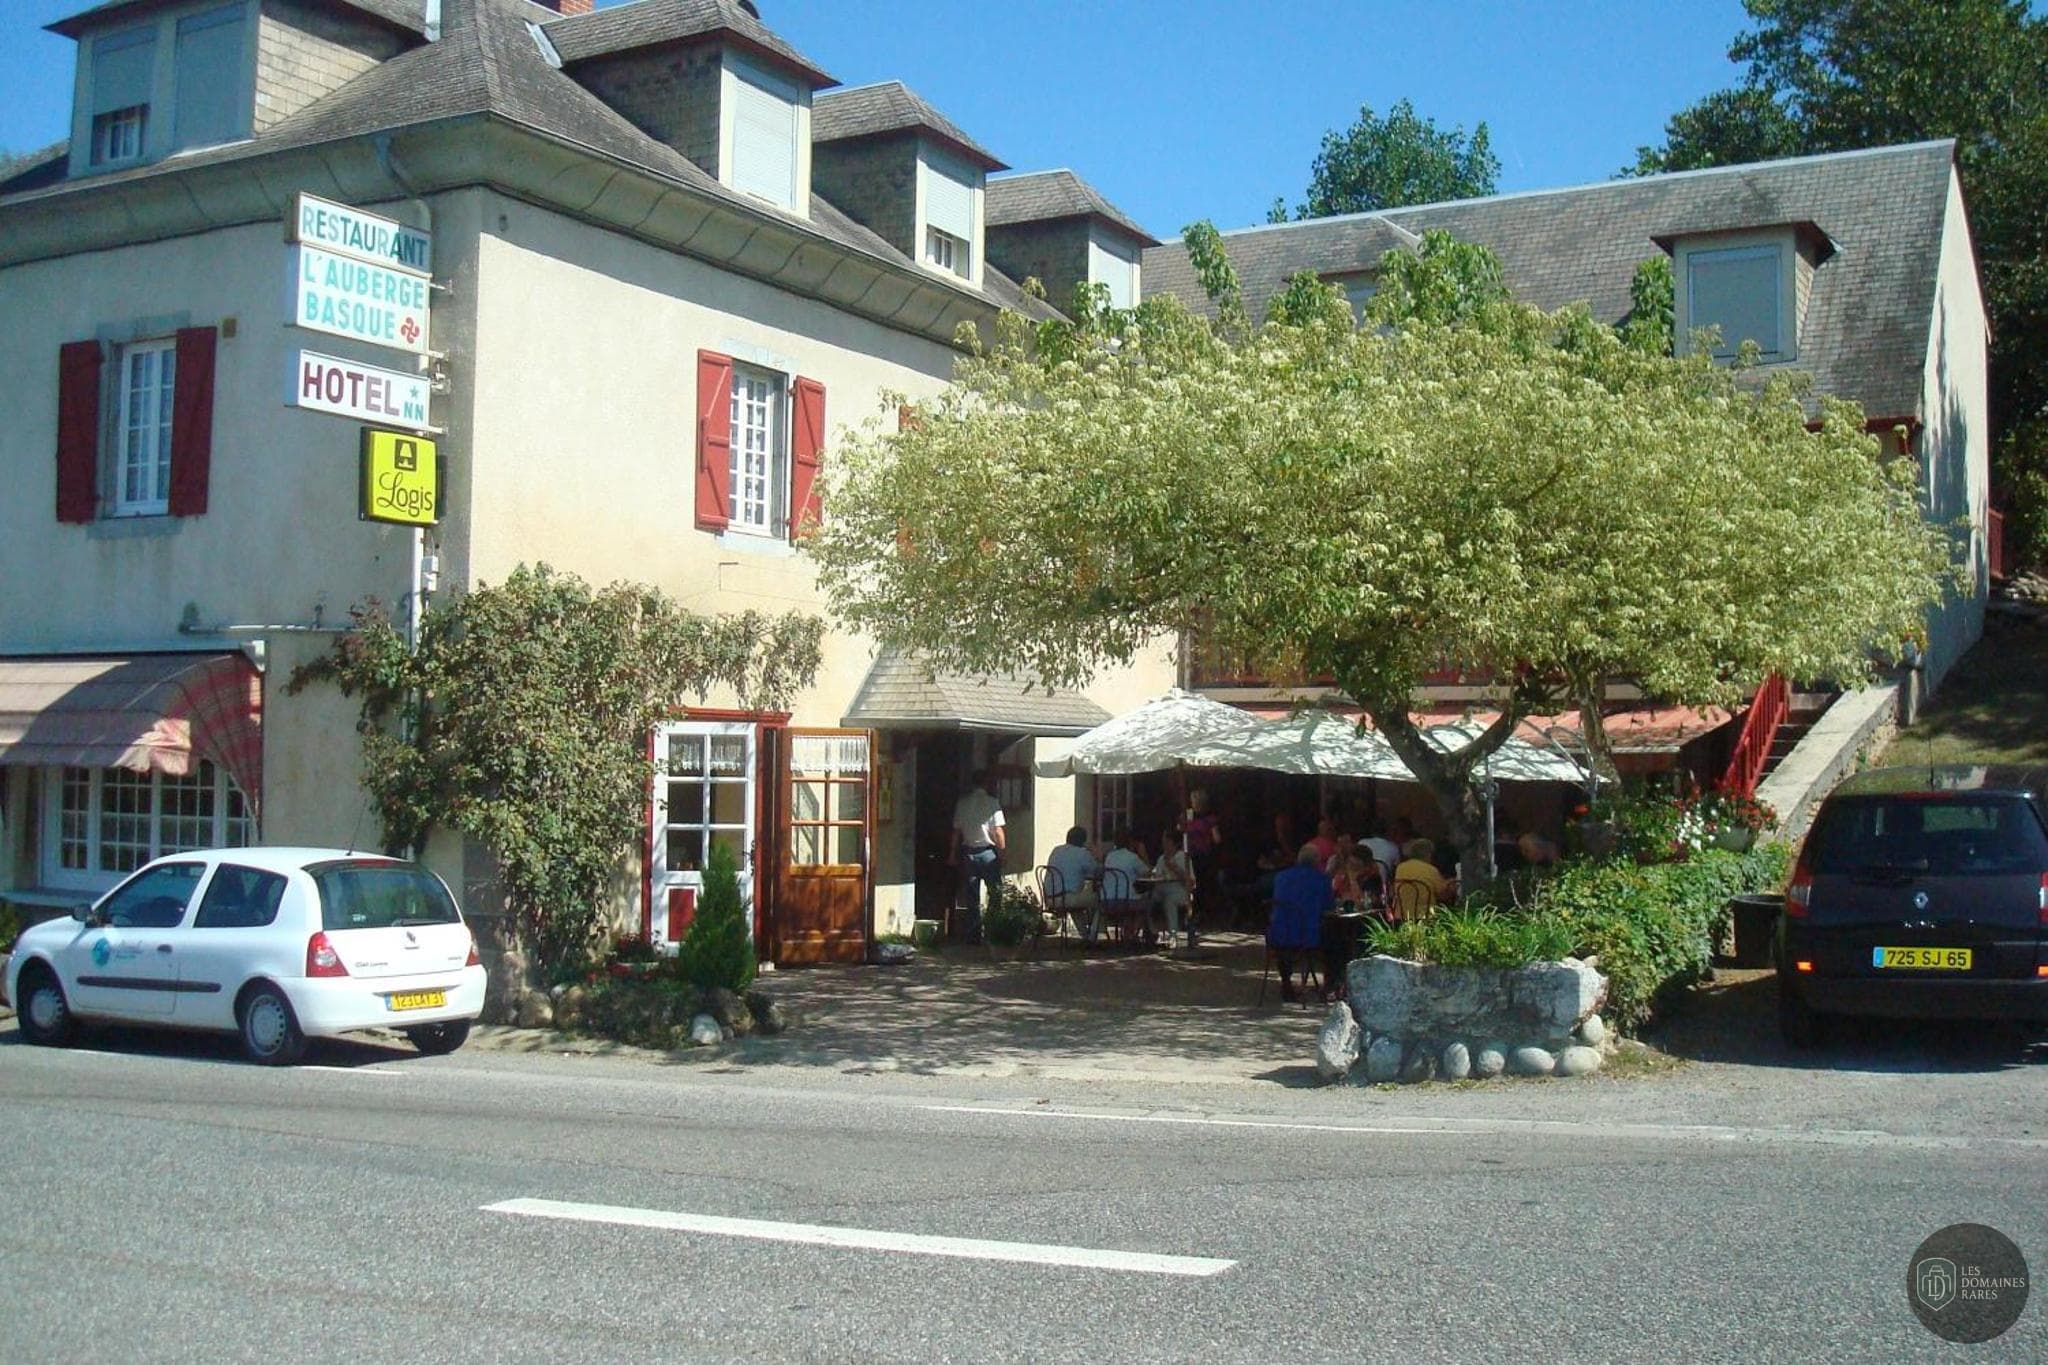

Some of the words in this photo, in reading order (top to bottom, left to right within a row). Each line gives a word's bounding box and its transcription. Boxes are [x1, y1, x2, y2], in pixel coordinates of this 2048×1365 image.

[303, 206, 427, 266] RESTAURANT
[304, 253, 424, 309] L'AUBERGE
[306, 292, 395, 340] BASQUE
[303, 362, 399, 416] HOTEL
[403, 402, 424, 421] NN
[376, 472, 433, 518] Logis
[1887, 951, 1915, 966] 725
[1922, 951, 1941, 966] SJ
[1946, 951, 1967, 967] 65
